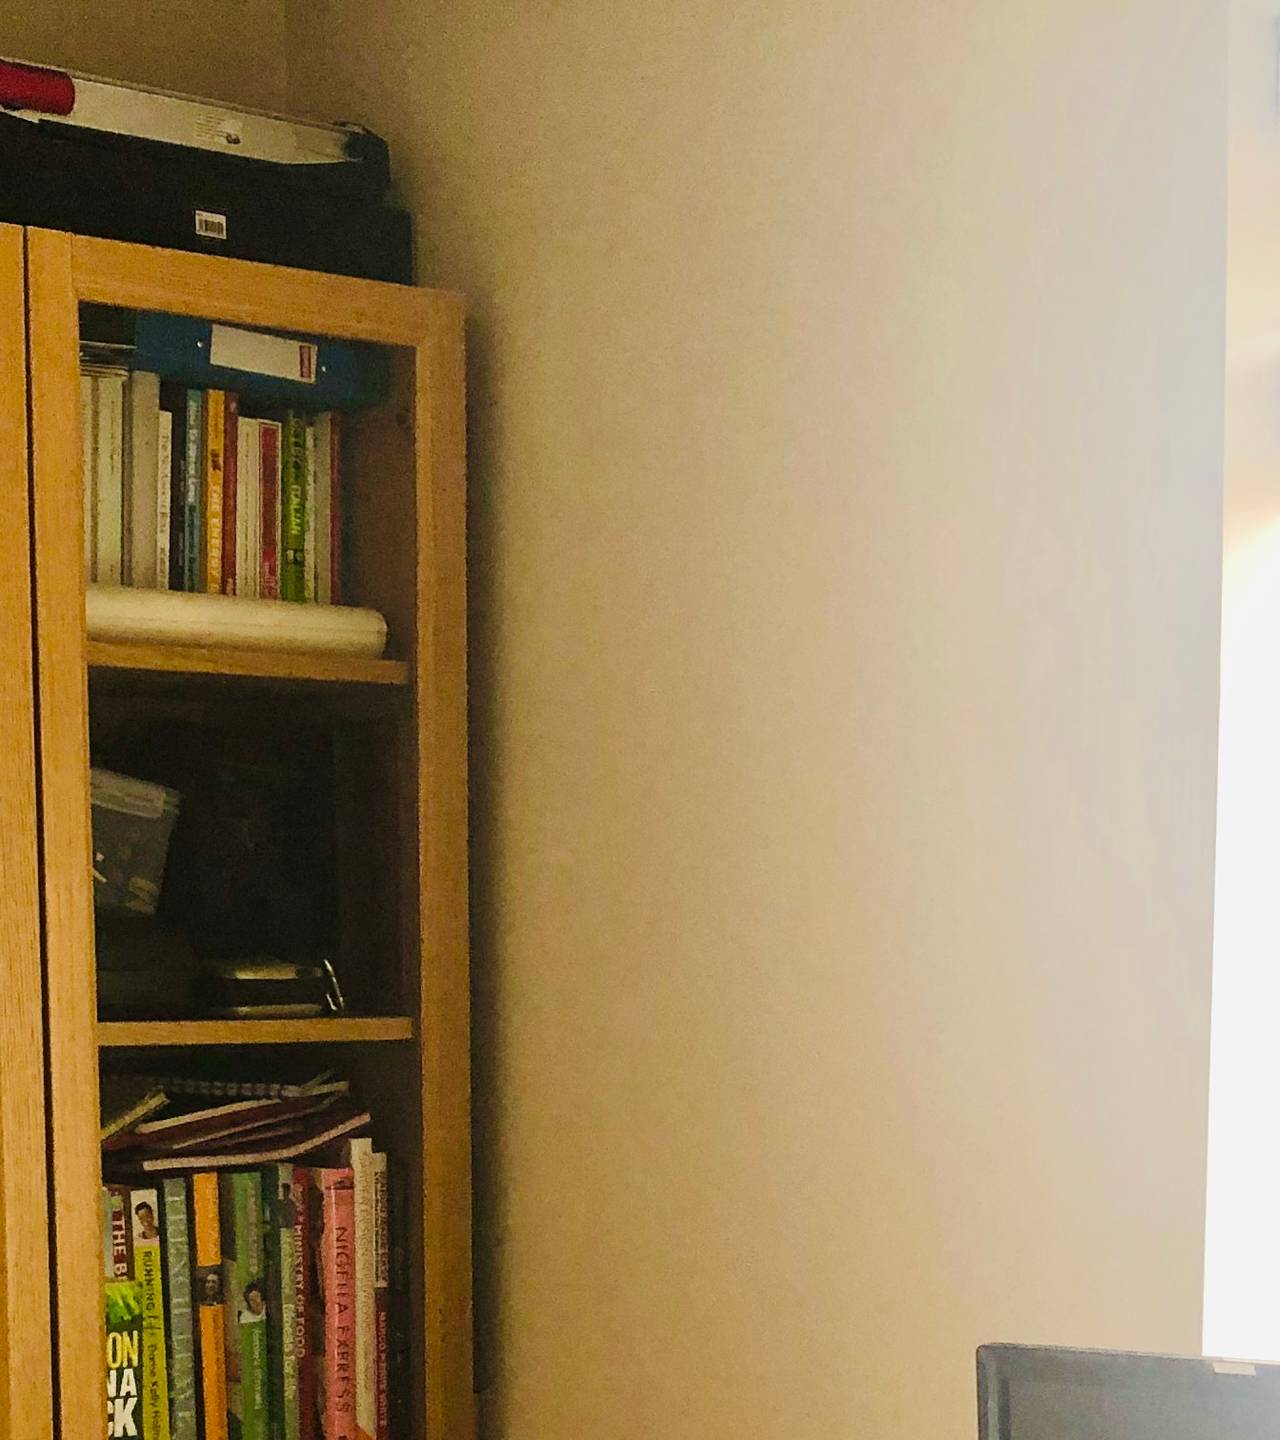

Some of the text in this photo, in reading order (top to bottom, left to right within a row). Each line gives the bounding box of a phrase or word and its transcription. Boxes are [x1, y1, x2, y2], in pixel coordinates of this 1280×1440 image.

[144, 1250, 158, 1311] RUNNING
[293, 1225, 306, 1289] MINISTRY
[294, 1294, 306, 1315] OF
[335, 1226, 352, 1413] NIGELLA EXPRESS
[147, 1343, 158, 1377] Dame
[295, 1317, 307, 1358] FOOD
